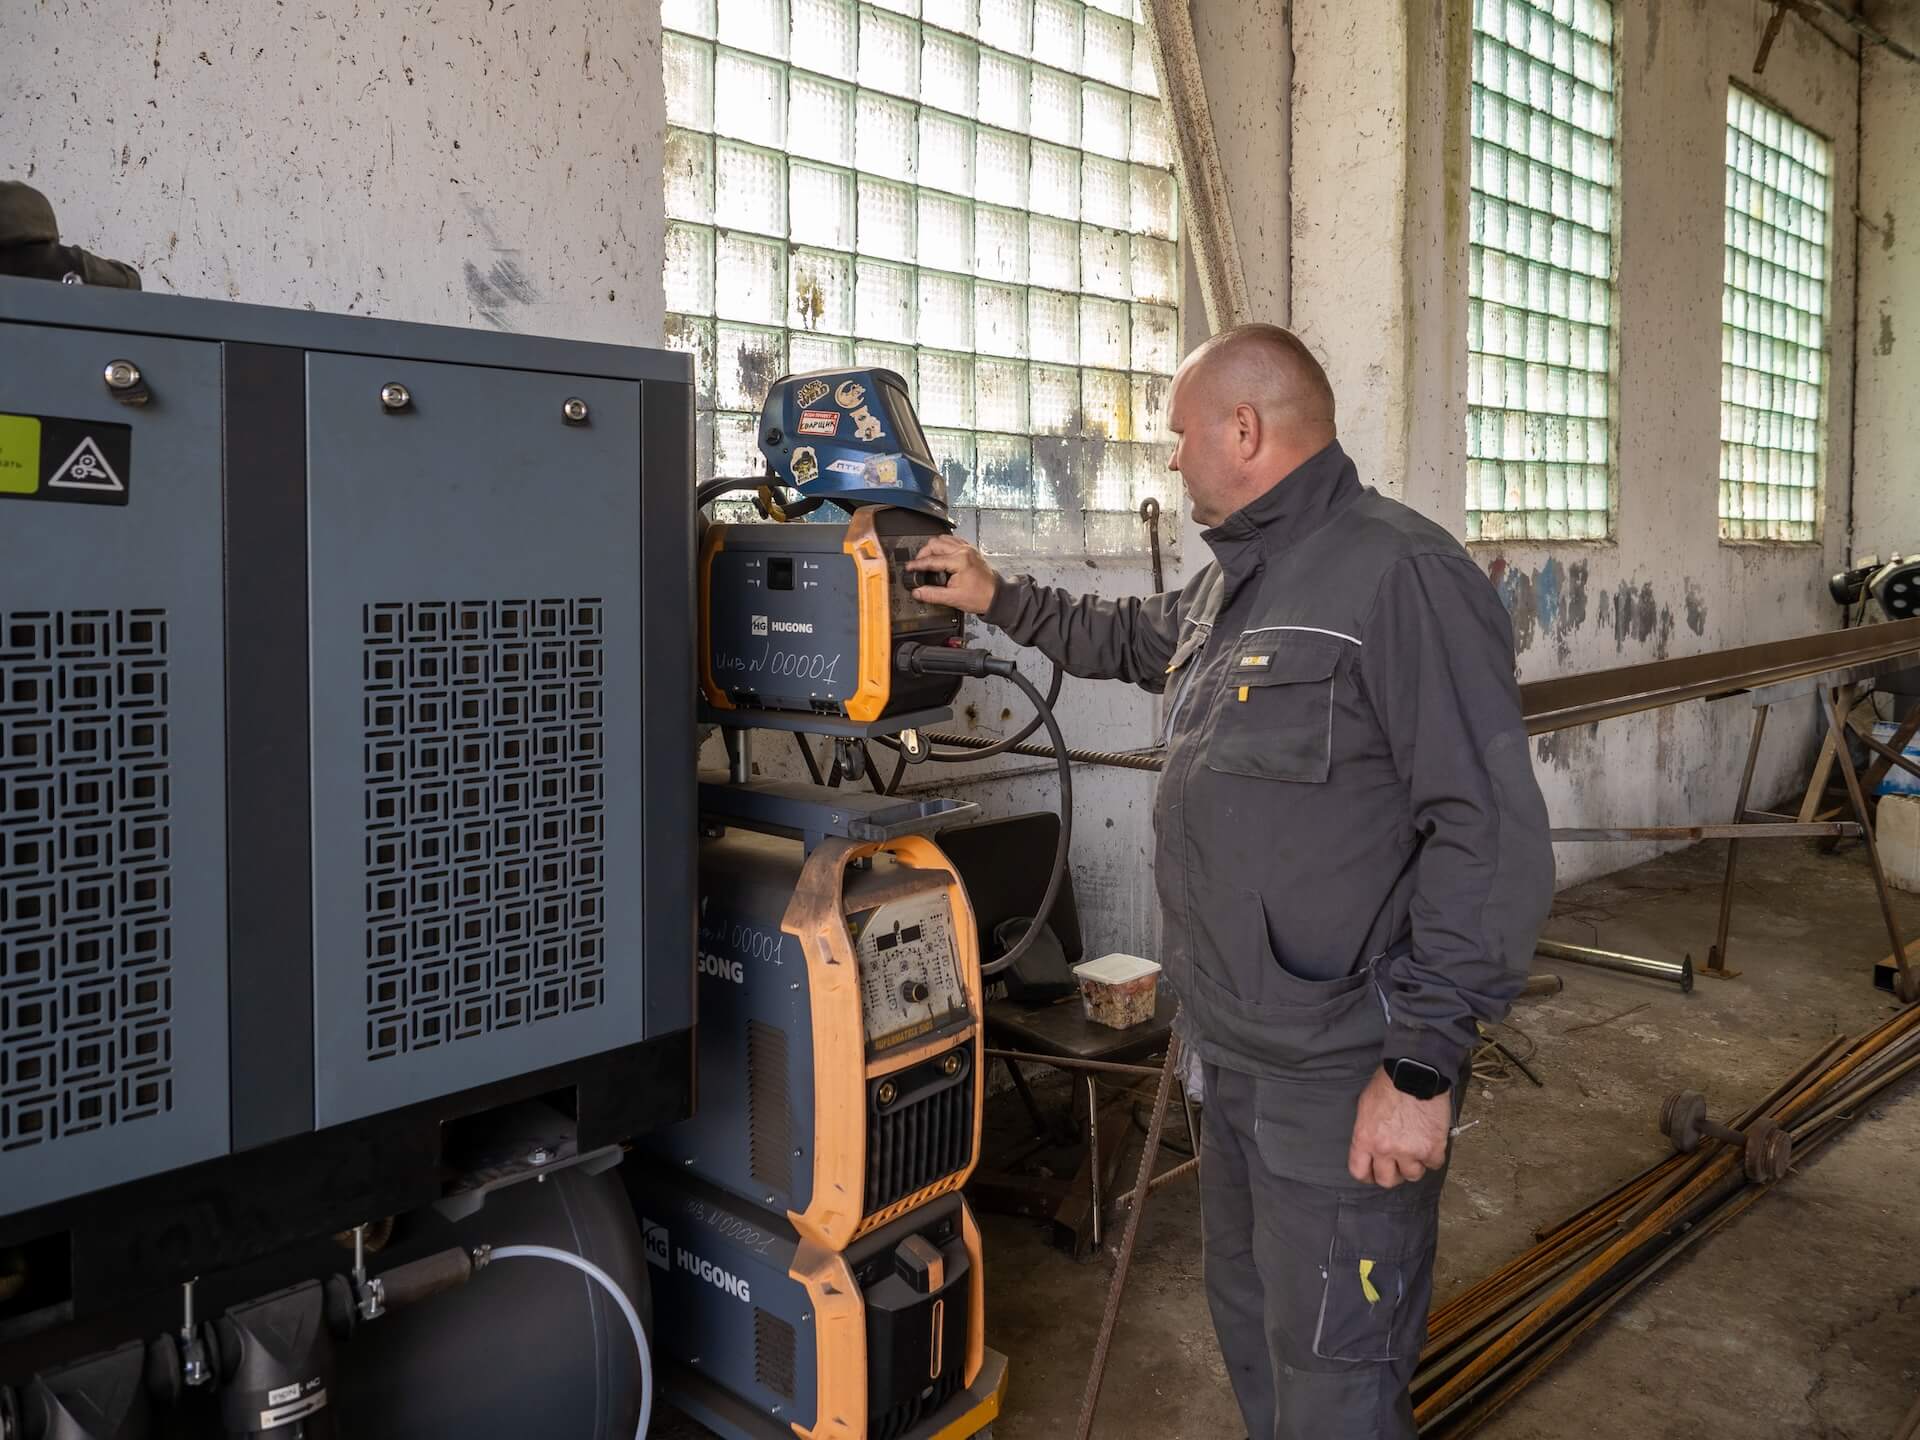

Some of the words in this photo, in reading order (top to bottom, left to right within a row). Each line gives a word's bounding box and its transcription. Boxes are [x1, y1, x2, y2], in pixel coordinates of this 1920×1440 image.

[771, 621, 813, 634] HUGONG
[771, 651, 840, 684] 00001
[731, 926, 783, 966] 00001
[697, 952, 744, 984] GONG
[677, 1247, 750, 1302] HUGONG
